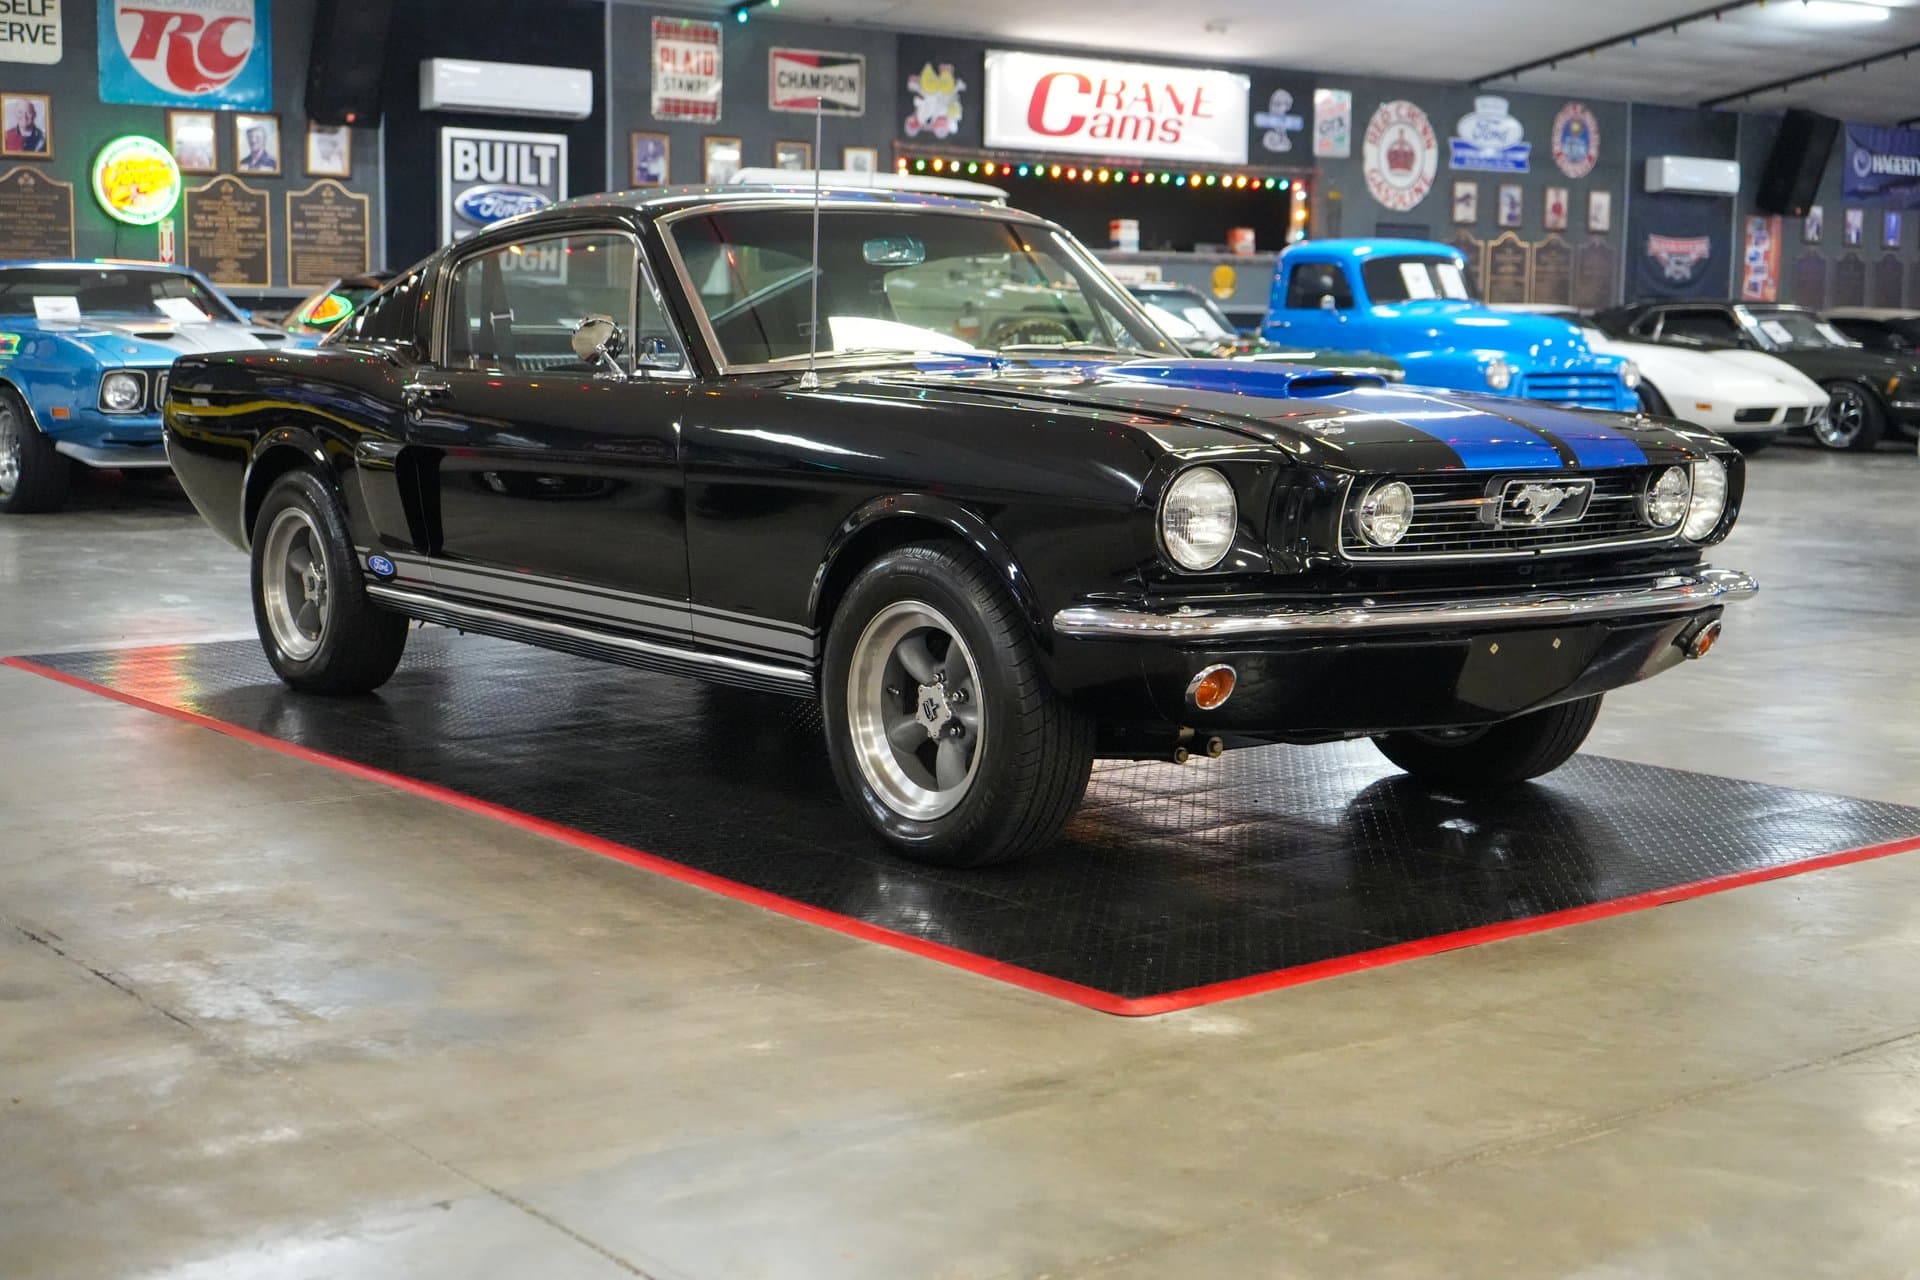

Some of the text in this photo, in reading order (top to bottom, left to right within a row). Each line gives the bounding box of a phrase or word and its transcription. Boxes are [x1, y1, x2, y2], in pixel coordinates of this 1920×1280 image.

[0, 0, 55, 16] SELF
[0, 21, 56, 45] ERVE
[120, 8, 252, 92] RC
[660, 47, 714, 77] PLAID
[777, 70, 856, 93] CHAMPION
[453, 139, 558, 187] BUILT
